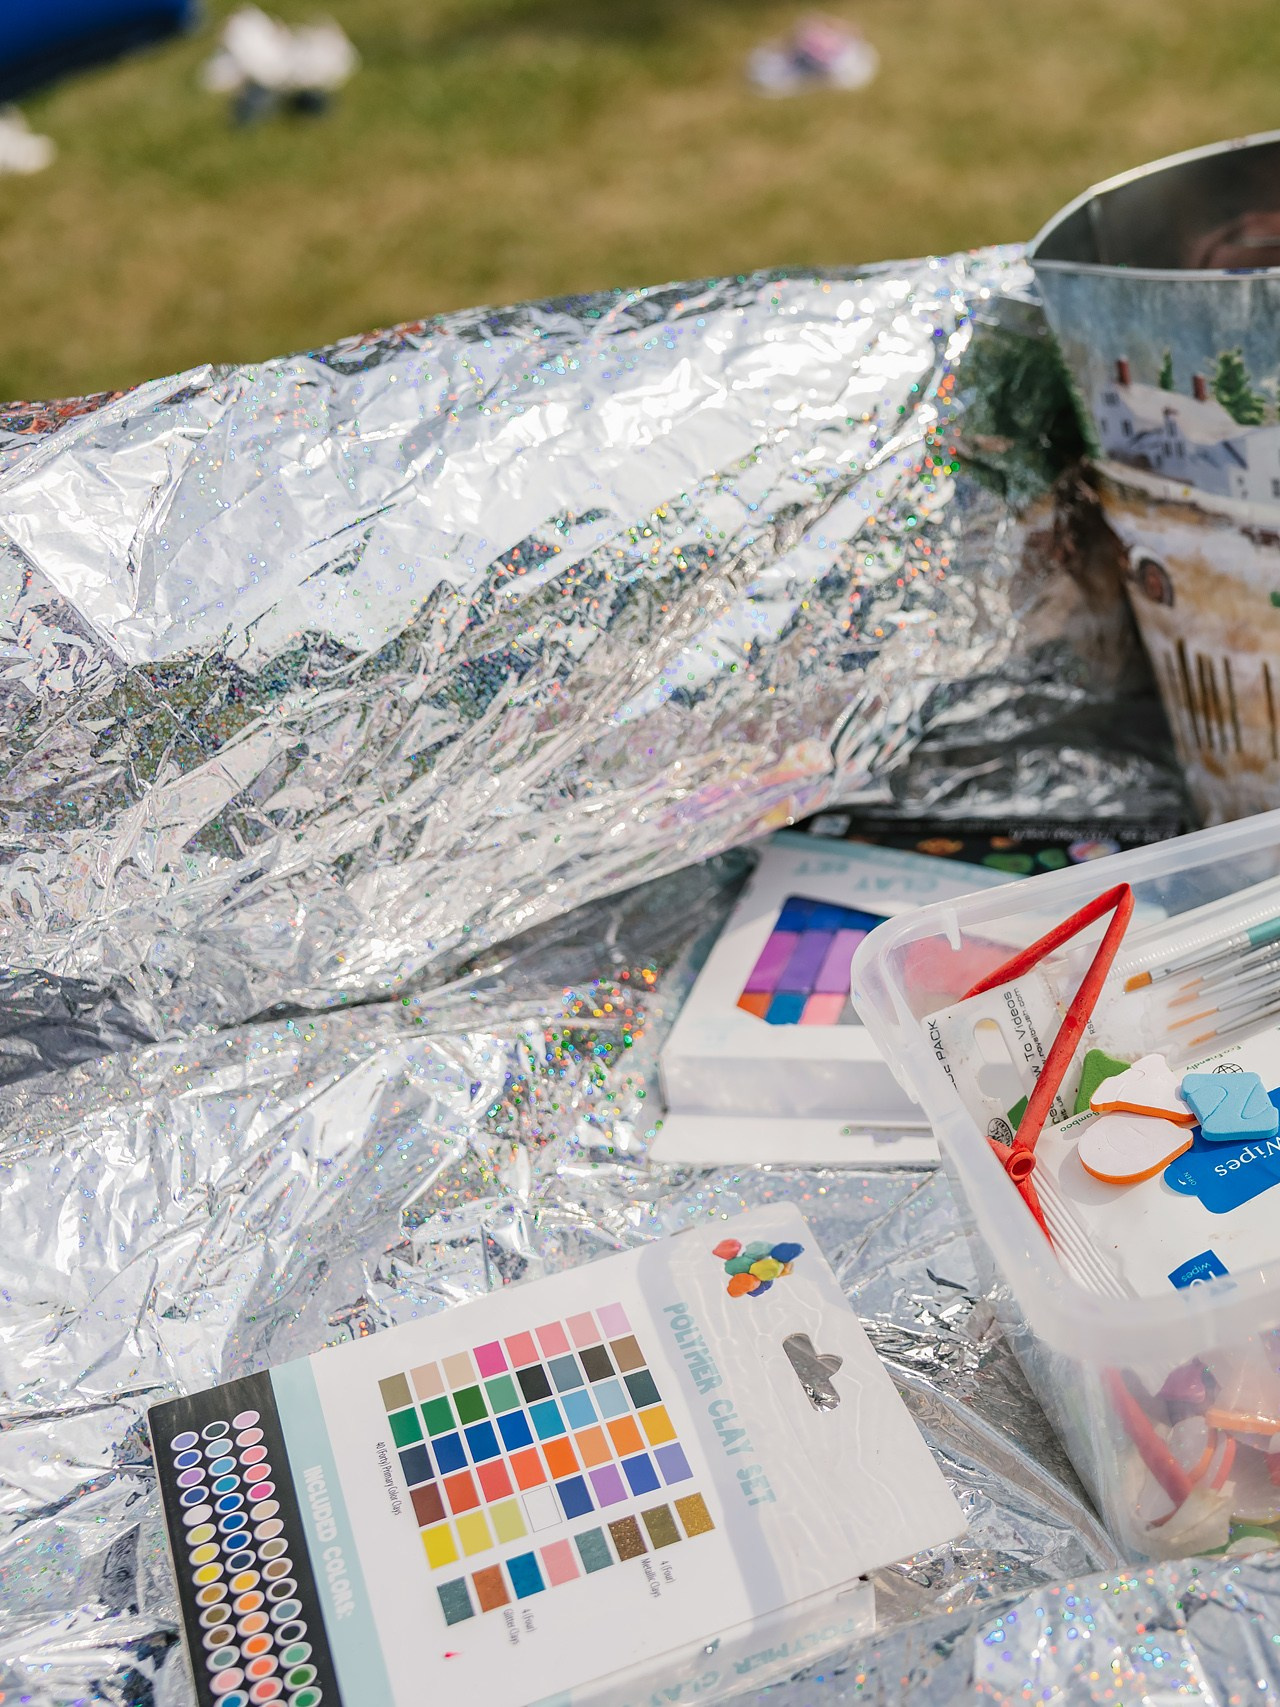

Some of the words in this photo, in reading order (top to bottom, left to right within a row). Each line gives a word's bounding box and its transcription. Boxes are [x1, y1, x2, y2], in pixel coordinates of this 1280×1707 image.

[1002, 990, 1027, 1040] Videos
[928, 1019, 945, 1061] PACK
[1021, 1042, 1036, 1061] To
[1060, 1111, 1100, 1132] Bamboo
[1183, 1171, 1196, 1186] OPEN
[1180, 1261, 1211, 1282] wipes
[663, 1301, 724, 1395] POLYMER
[706, 1396, 754, 1460] CLAY
[734, 1462, 776, 1509] SET
[376, 1449, 390, 1466] (Forty)
[382, 1465, 394, 1487] Primary
[388, 1487, 399, 1500] Color
[391, 1500, 403, 1516] Clays
[301, 1465, 338, 1542] INCLUDED
[321, 1545, 356, 1619] COLORS:
[641, 1558, 656, 1581] Metallic
[649, 1581, 661, 1597] Clays
[661, 1565, 675, 1584] (Four)
[504, 1609, 515, 1627] Glitter
[523, 1613, 536, 1632] (Four)
[508, 1628, 521, 1645] Clays
